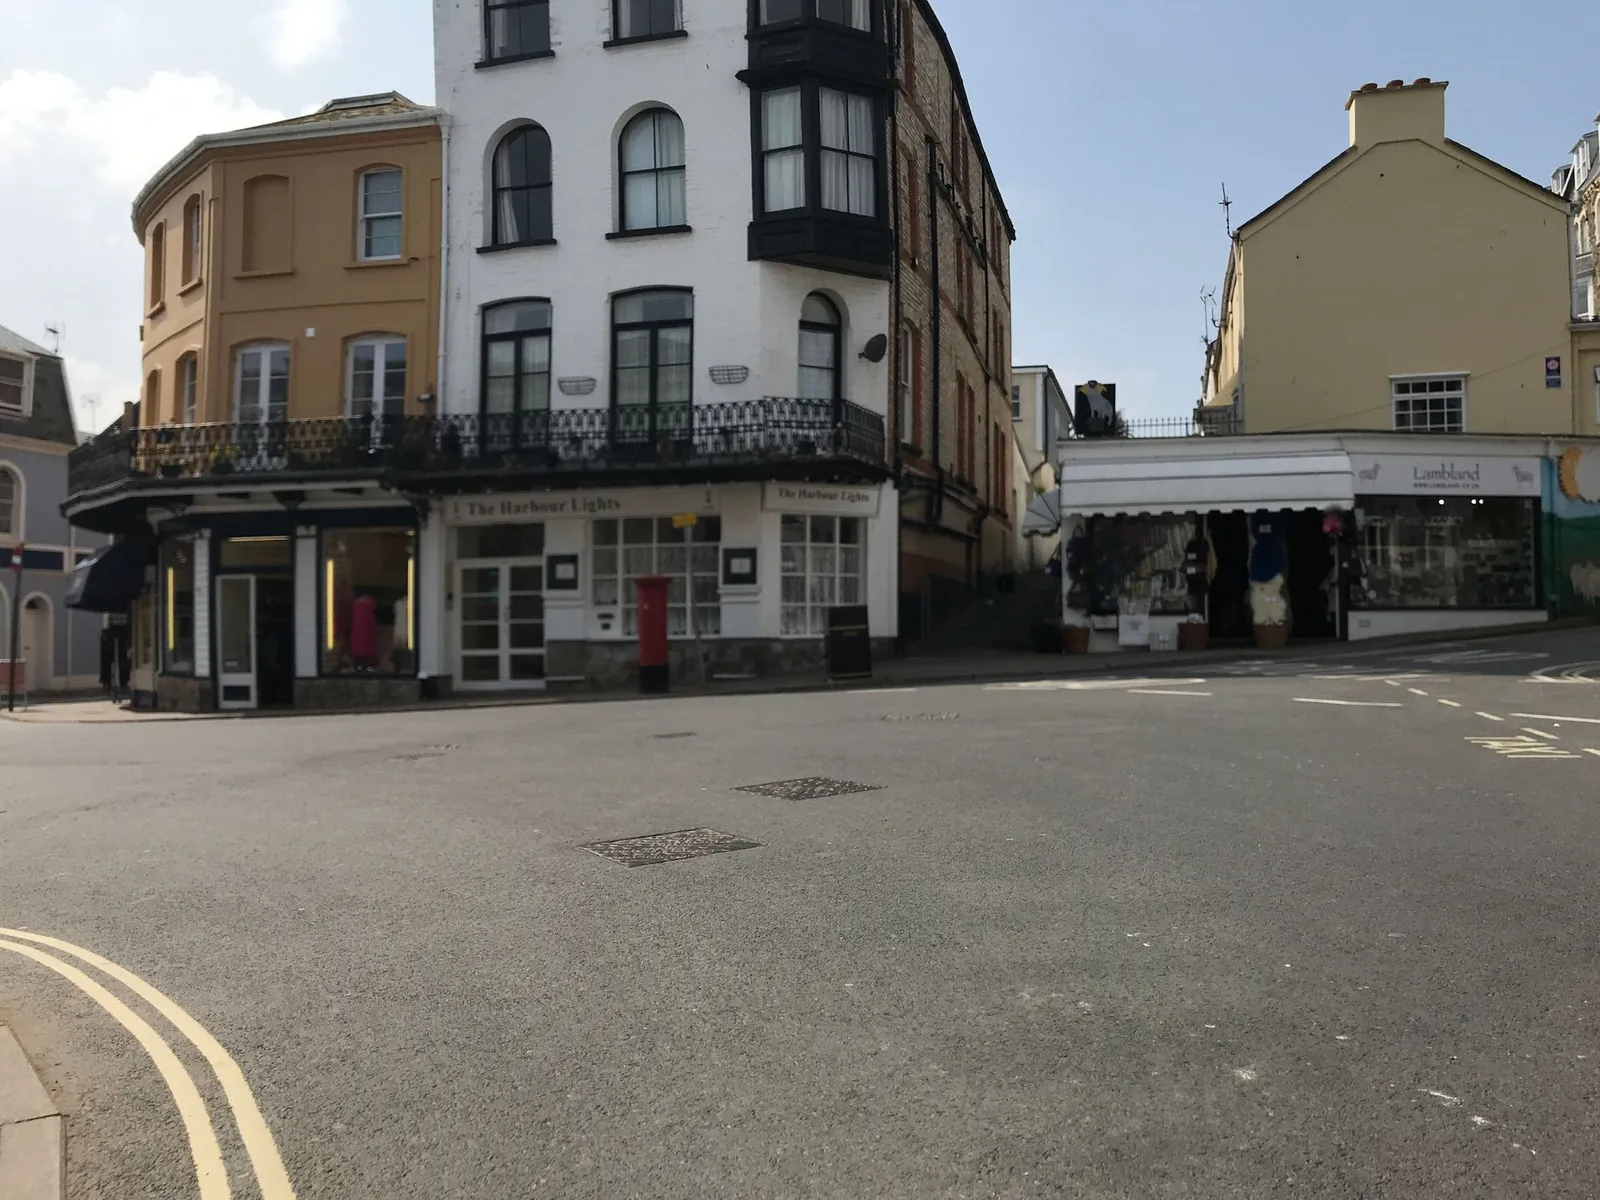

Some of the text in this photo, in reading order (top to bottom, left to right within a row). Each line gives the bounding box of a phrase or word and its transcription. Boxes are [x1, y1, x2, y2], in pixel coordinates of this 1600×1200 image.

[1412, 462, 1480, 481] Lambland
[778, 487, 870, 503] The Harbour Lights
[468, 495, 621, 516] The Harbour Lights
